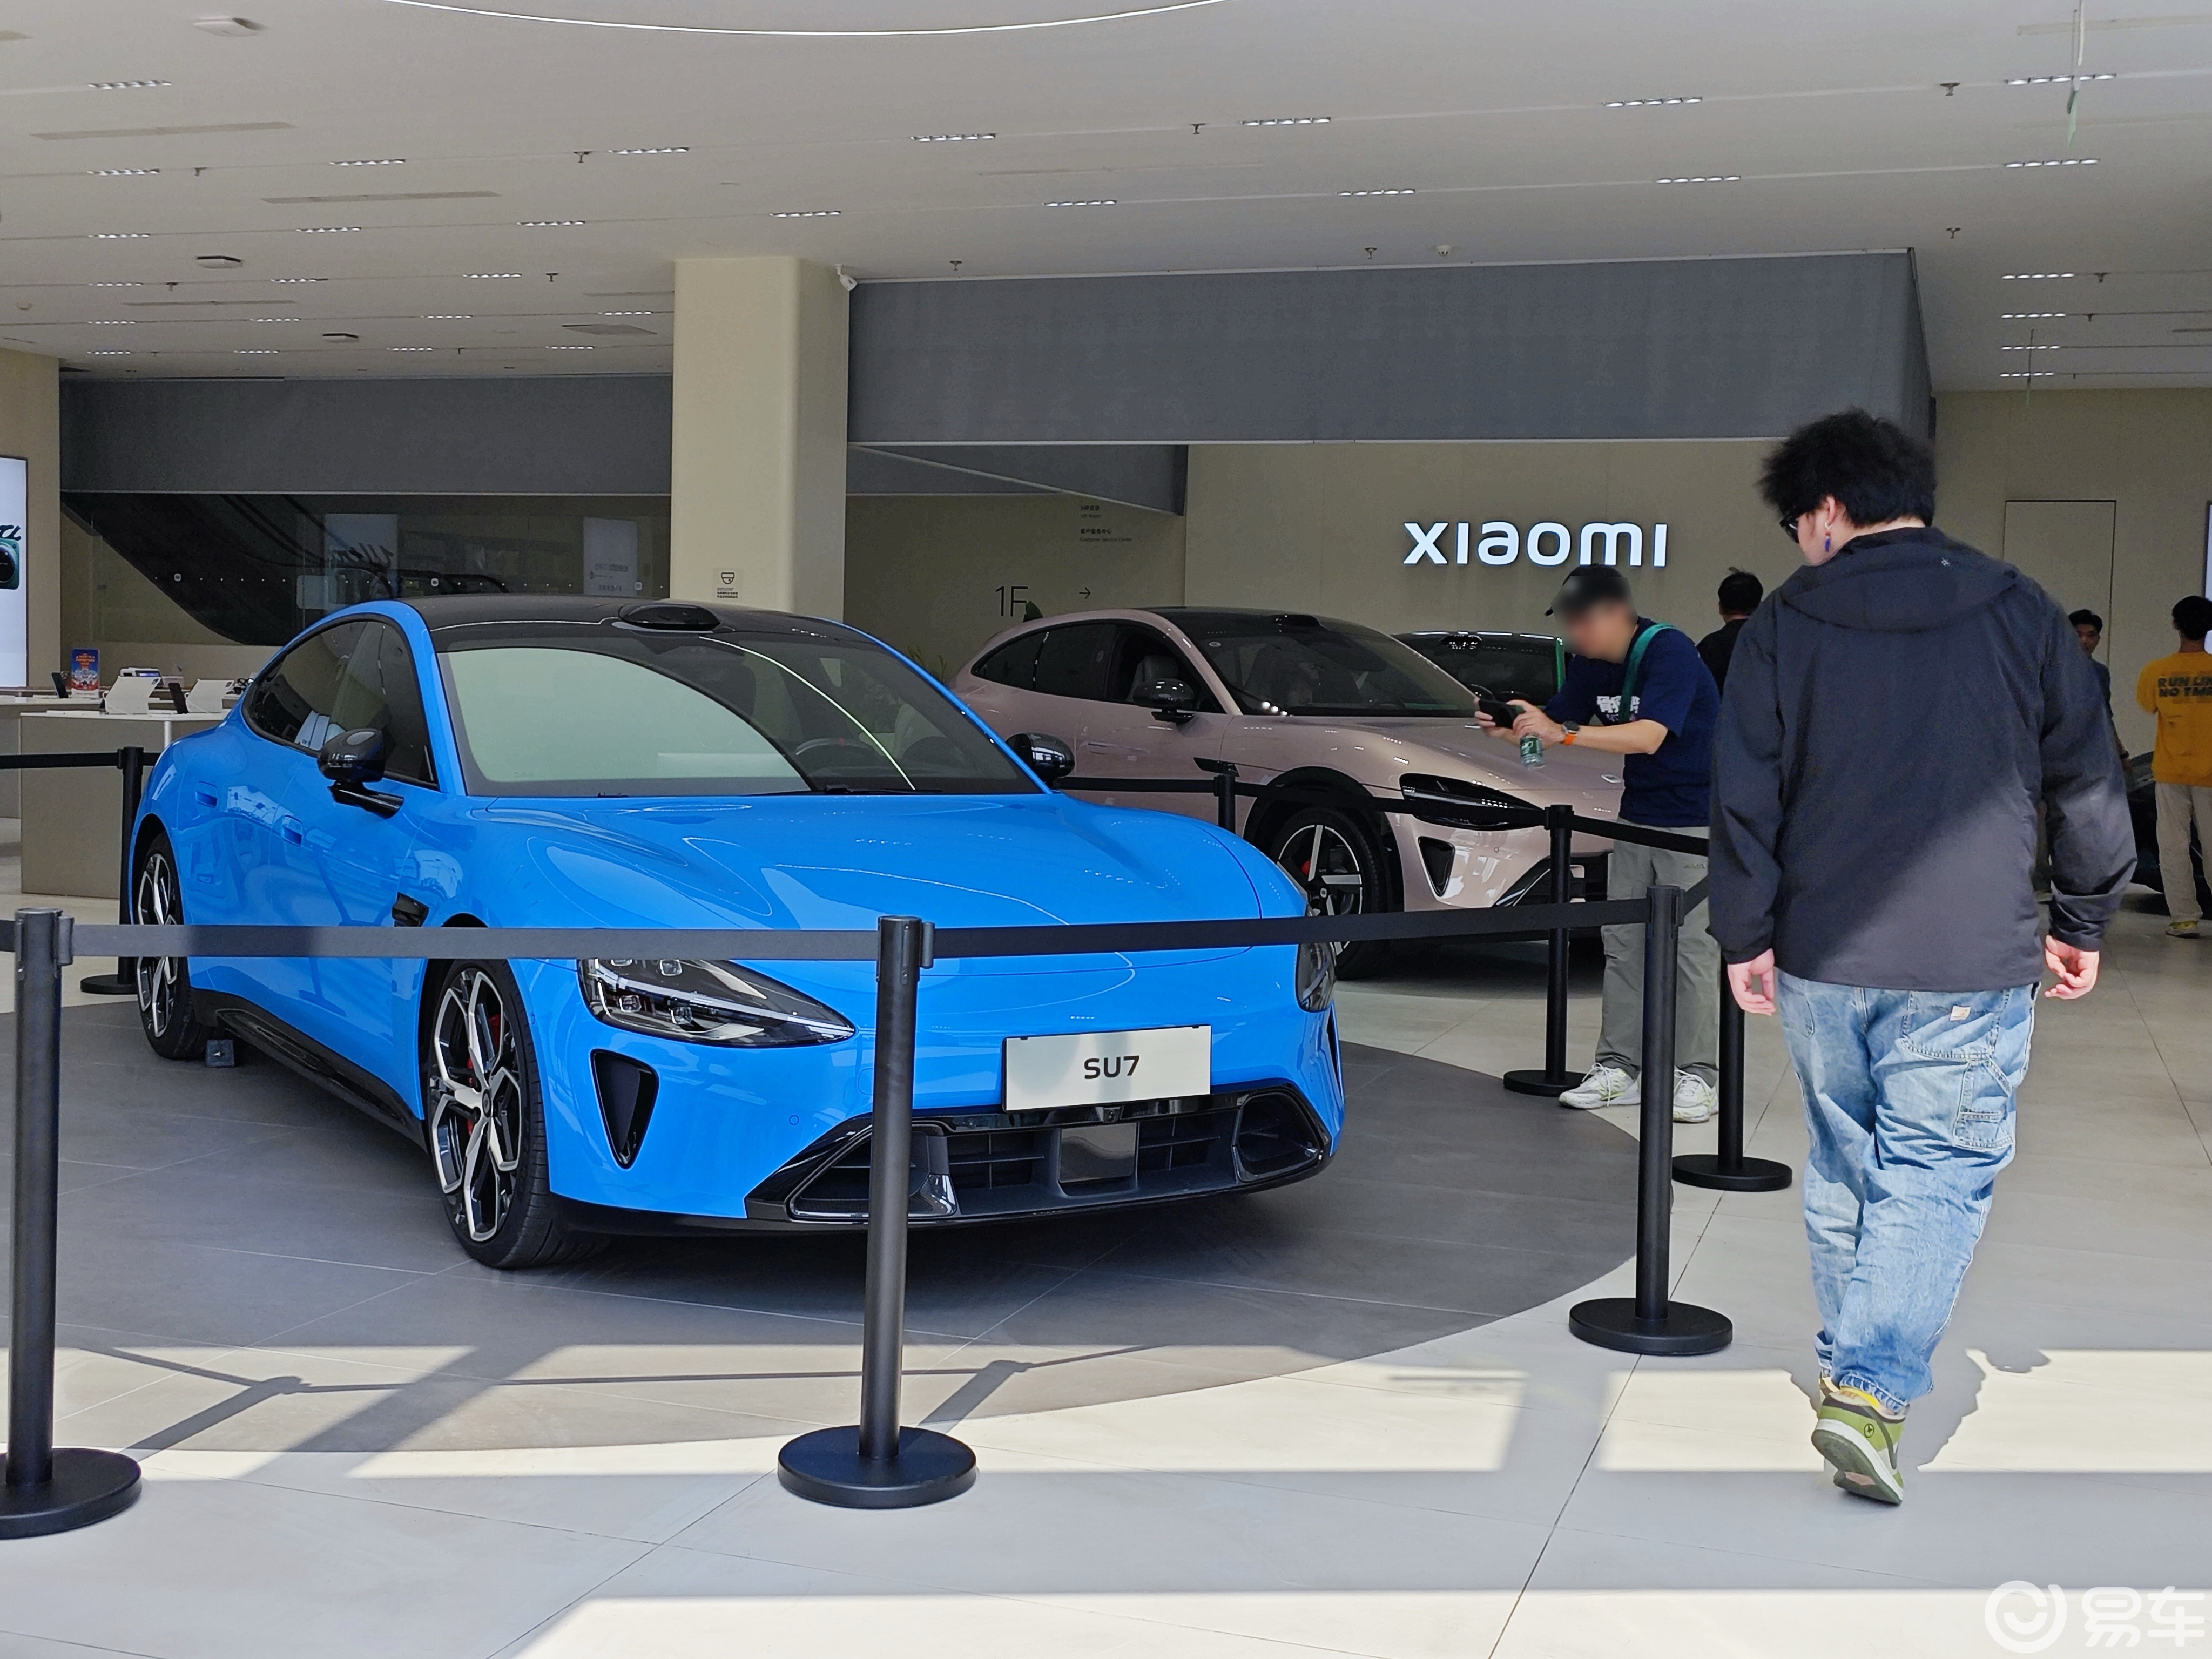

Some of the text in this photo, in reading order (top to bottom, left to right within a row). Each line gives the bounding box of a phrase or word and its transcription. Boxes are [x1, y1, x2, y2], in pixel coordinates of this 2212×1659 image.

[1403, 521, 1668, 567] xiaomi
[996, 586, 1028, 616] 1F
[2158, 676, 2189, 688] RUN
[2159, 687, 2180, 698] NO
[1084, 1055, 1139, 1079] SU7
